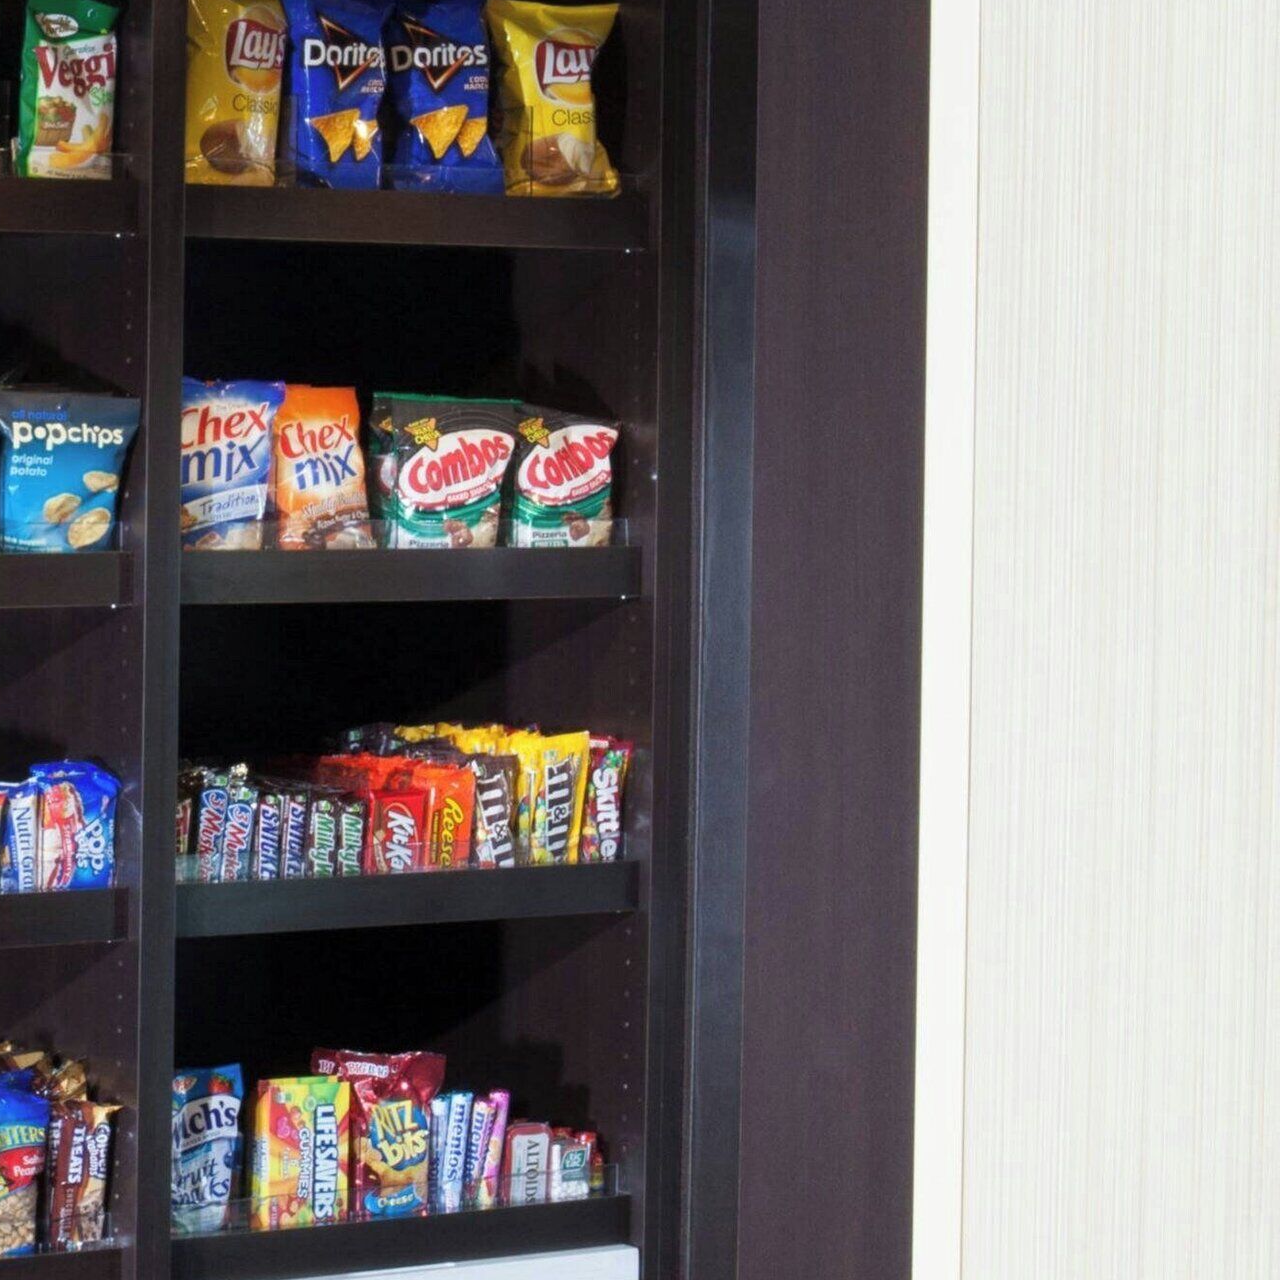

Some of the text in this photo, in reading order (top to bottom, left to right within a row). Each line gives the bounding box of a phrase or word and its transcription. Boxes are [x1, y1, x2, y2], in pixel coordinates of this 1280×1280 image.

[390, 44, 488, 72] Doritos
[11, 421, 124, 451] popchips
[279, 414, 354, 459] Chex
[10, 465, 47, 477] potato
[11, 454, 53, 466] original
[181, 434, 266, 486] mix
[294, 444, 357, 490] mix
[408, 435, 510, 495] Combos
[200, 493, 260, 516] Tradition
[592, 767, 620, 862] Skittle
[176, 1100, 237, 1144] lch's
[447, 1103, 466, 1182] mentos
[67, 1125, 87, 1184] TREATS
[297, 1128, 312, 1199] GUMMIES
[525, 1138, 541, 1204] ALTOIDS
